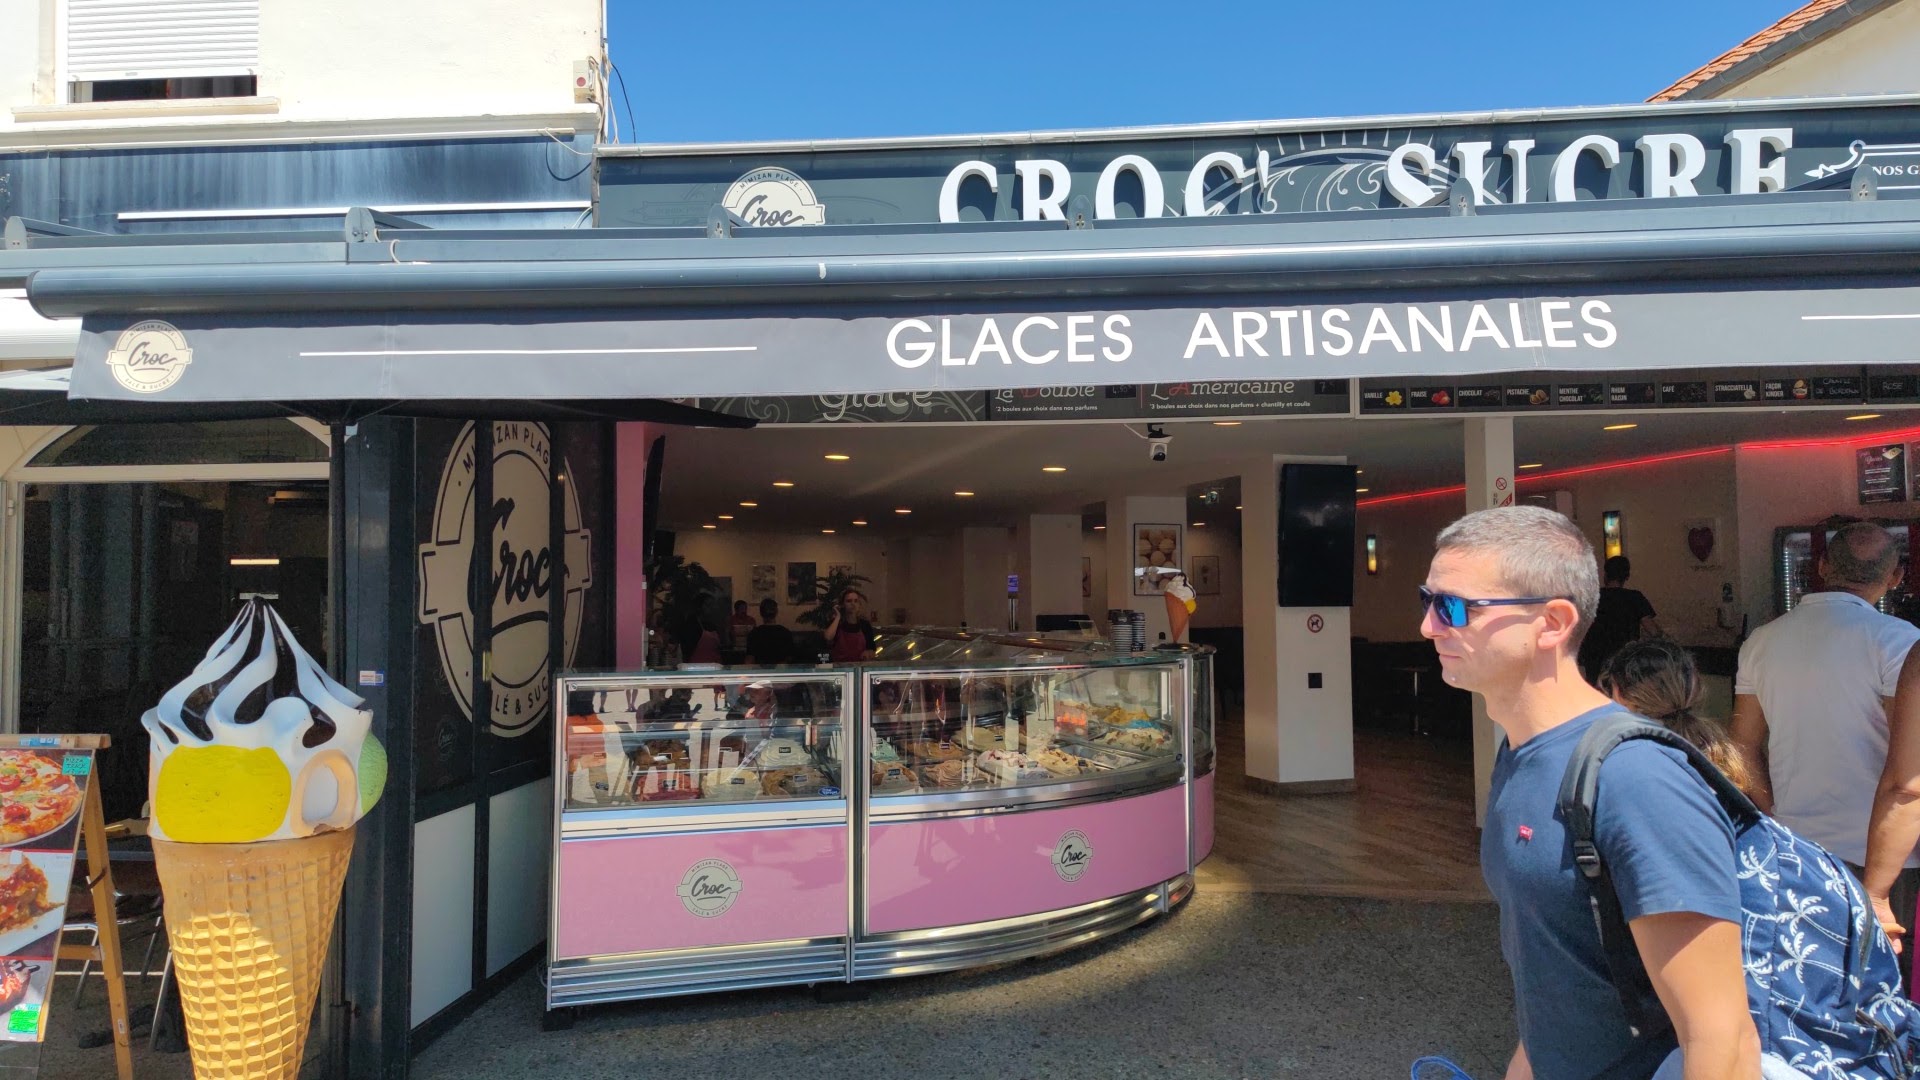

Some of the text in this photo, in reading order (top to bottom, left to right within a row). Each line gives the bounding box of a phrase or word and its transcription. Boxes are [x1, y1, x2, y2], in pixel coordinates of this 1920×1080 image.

[1872, 165, 1903, 176] NOS
[1907, 164, 1920, 176] G
[739, 172, 799, 189] MIMIZAN PLAGE
[740, 194, 805, 228] Croc
[886, 300, 1617, 369] GLACES ARTISANALES
[128, 341, 178, 367] Croc
[1506, 388, 1530, 396] PISTACHE
[1558, 387, 1579, 395] MENTHE
[1611, 386, 1626, 394] RHUM
[1765, 383, 1782, 391] FAÇON
[1363, 391, 1383, 399] VANILLE
[1458, 389, 1482, 397] CHOCOLAT
[1765, 390, 1784, 398] KINDER
[1033, 404, 1048, 412] choix
[1075, 403, 1098, 412] parfums
[1156, 402, 1175, 410] boules
[1260, 401, 1286, 409] chantilly
[524, 427, 550, 466] PLAG
[515, 698, 522, 715] &
[1061, 844, 1087, 864] Croc
[691, 875, 732, 897] Croc
